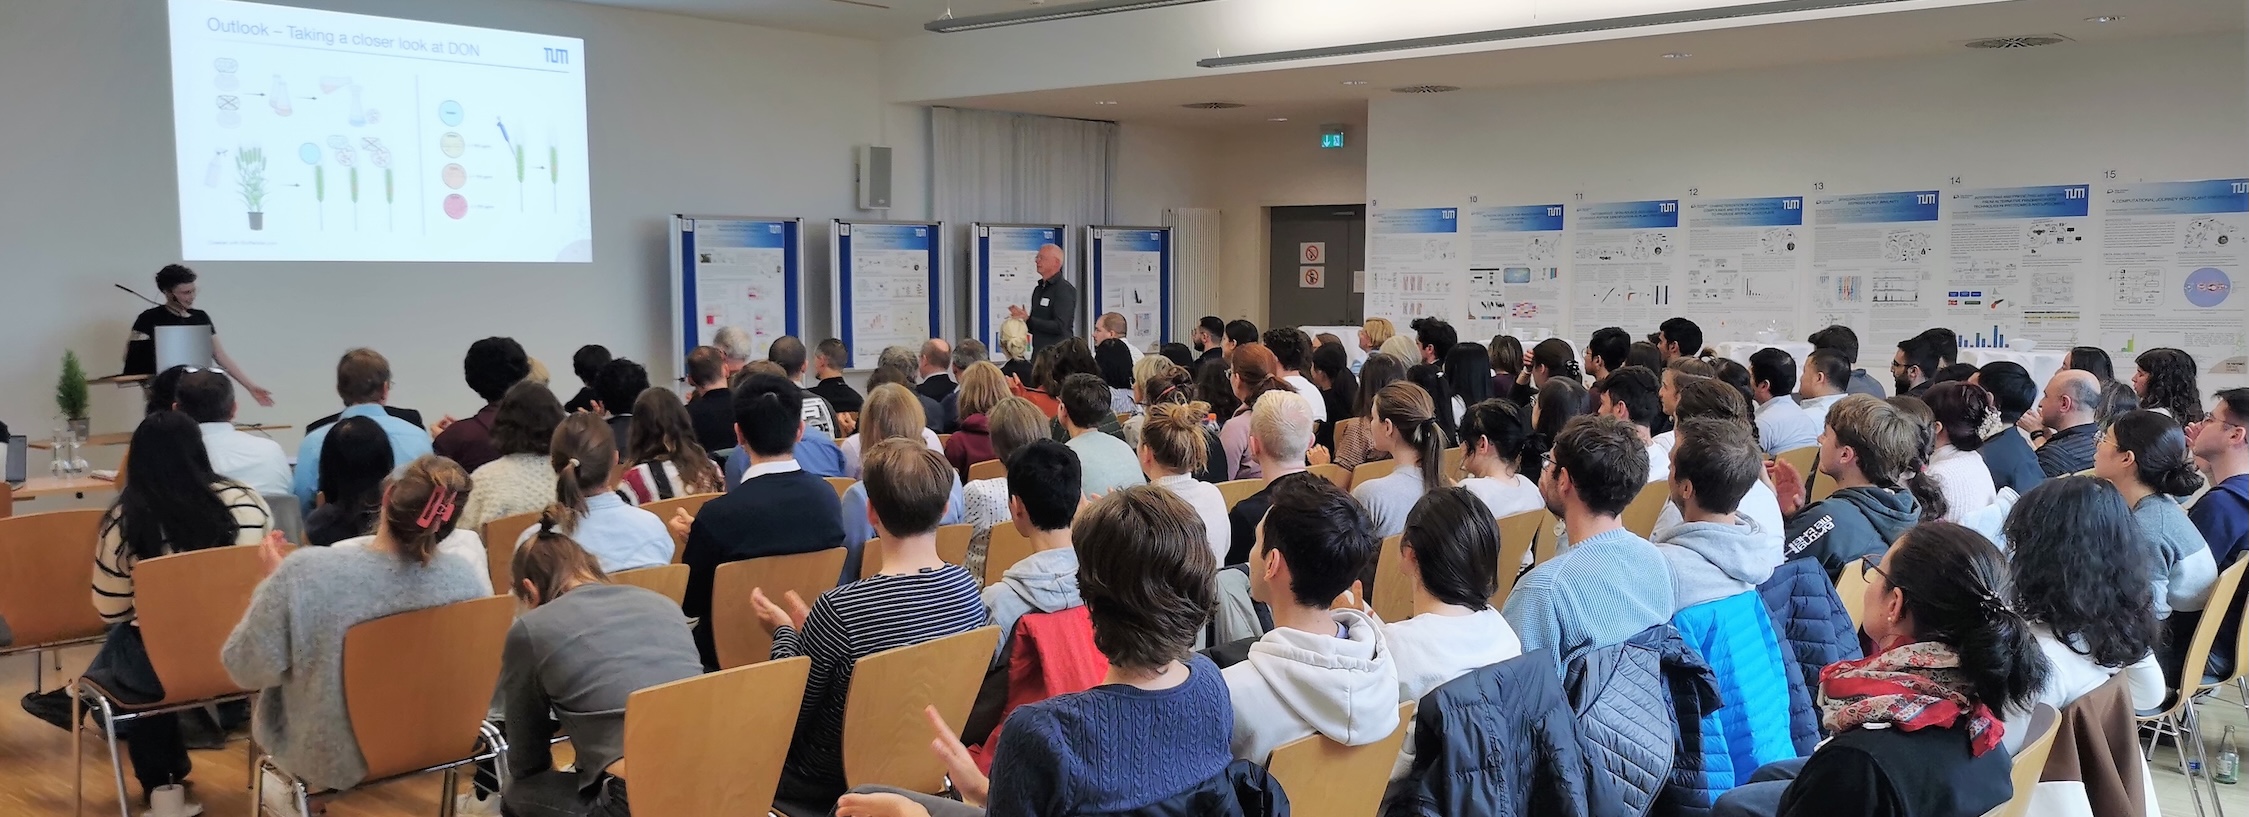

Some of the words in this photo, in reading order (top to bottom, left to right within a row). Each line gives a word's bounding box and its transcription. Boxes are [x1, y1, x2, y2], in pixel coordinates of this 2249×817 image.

[207, 17, 270, 36] Outlook
[287, 25, 335, 46] Taking
[339, 34, 348, 45] a
[352, 33, 394, 49] closer
[399, 37, 429, 52] look
[431, 41, 444, 54] at
[448, 42, 481, 57] DON
[543, 47, 569, 65] TUM
[2104, 170, 2117, 179] 15
[1814, 182, 1824, 190] 13
[1689, 188, 1698, 196] 12
[2064, 188, 2085, 200] TUM
[1372, 199, 1377, 207] 9
[1916, 194, 1936, 205] TUM
[1659, 203, 1676, 213] TUM
[1782, 200, 1800, 210] TUM
[1441, 210, 1455, 219] TUM
[1546, 207, 1561, 217] TUM
